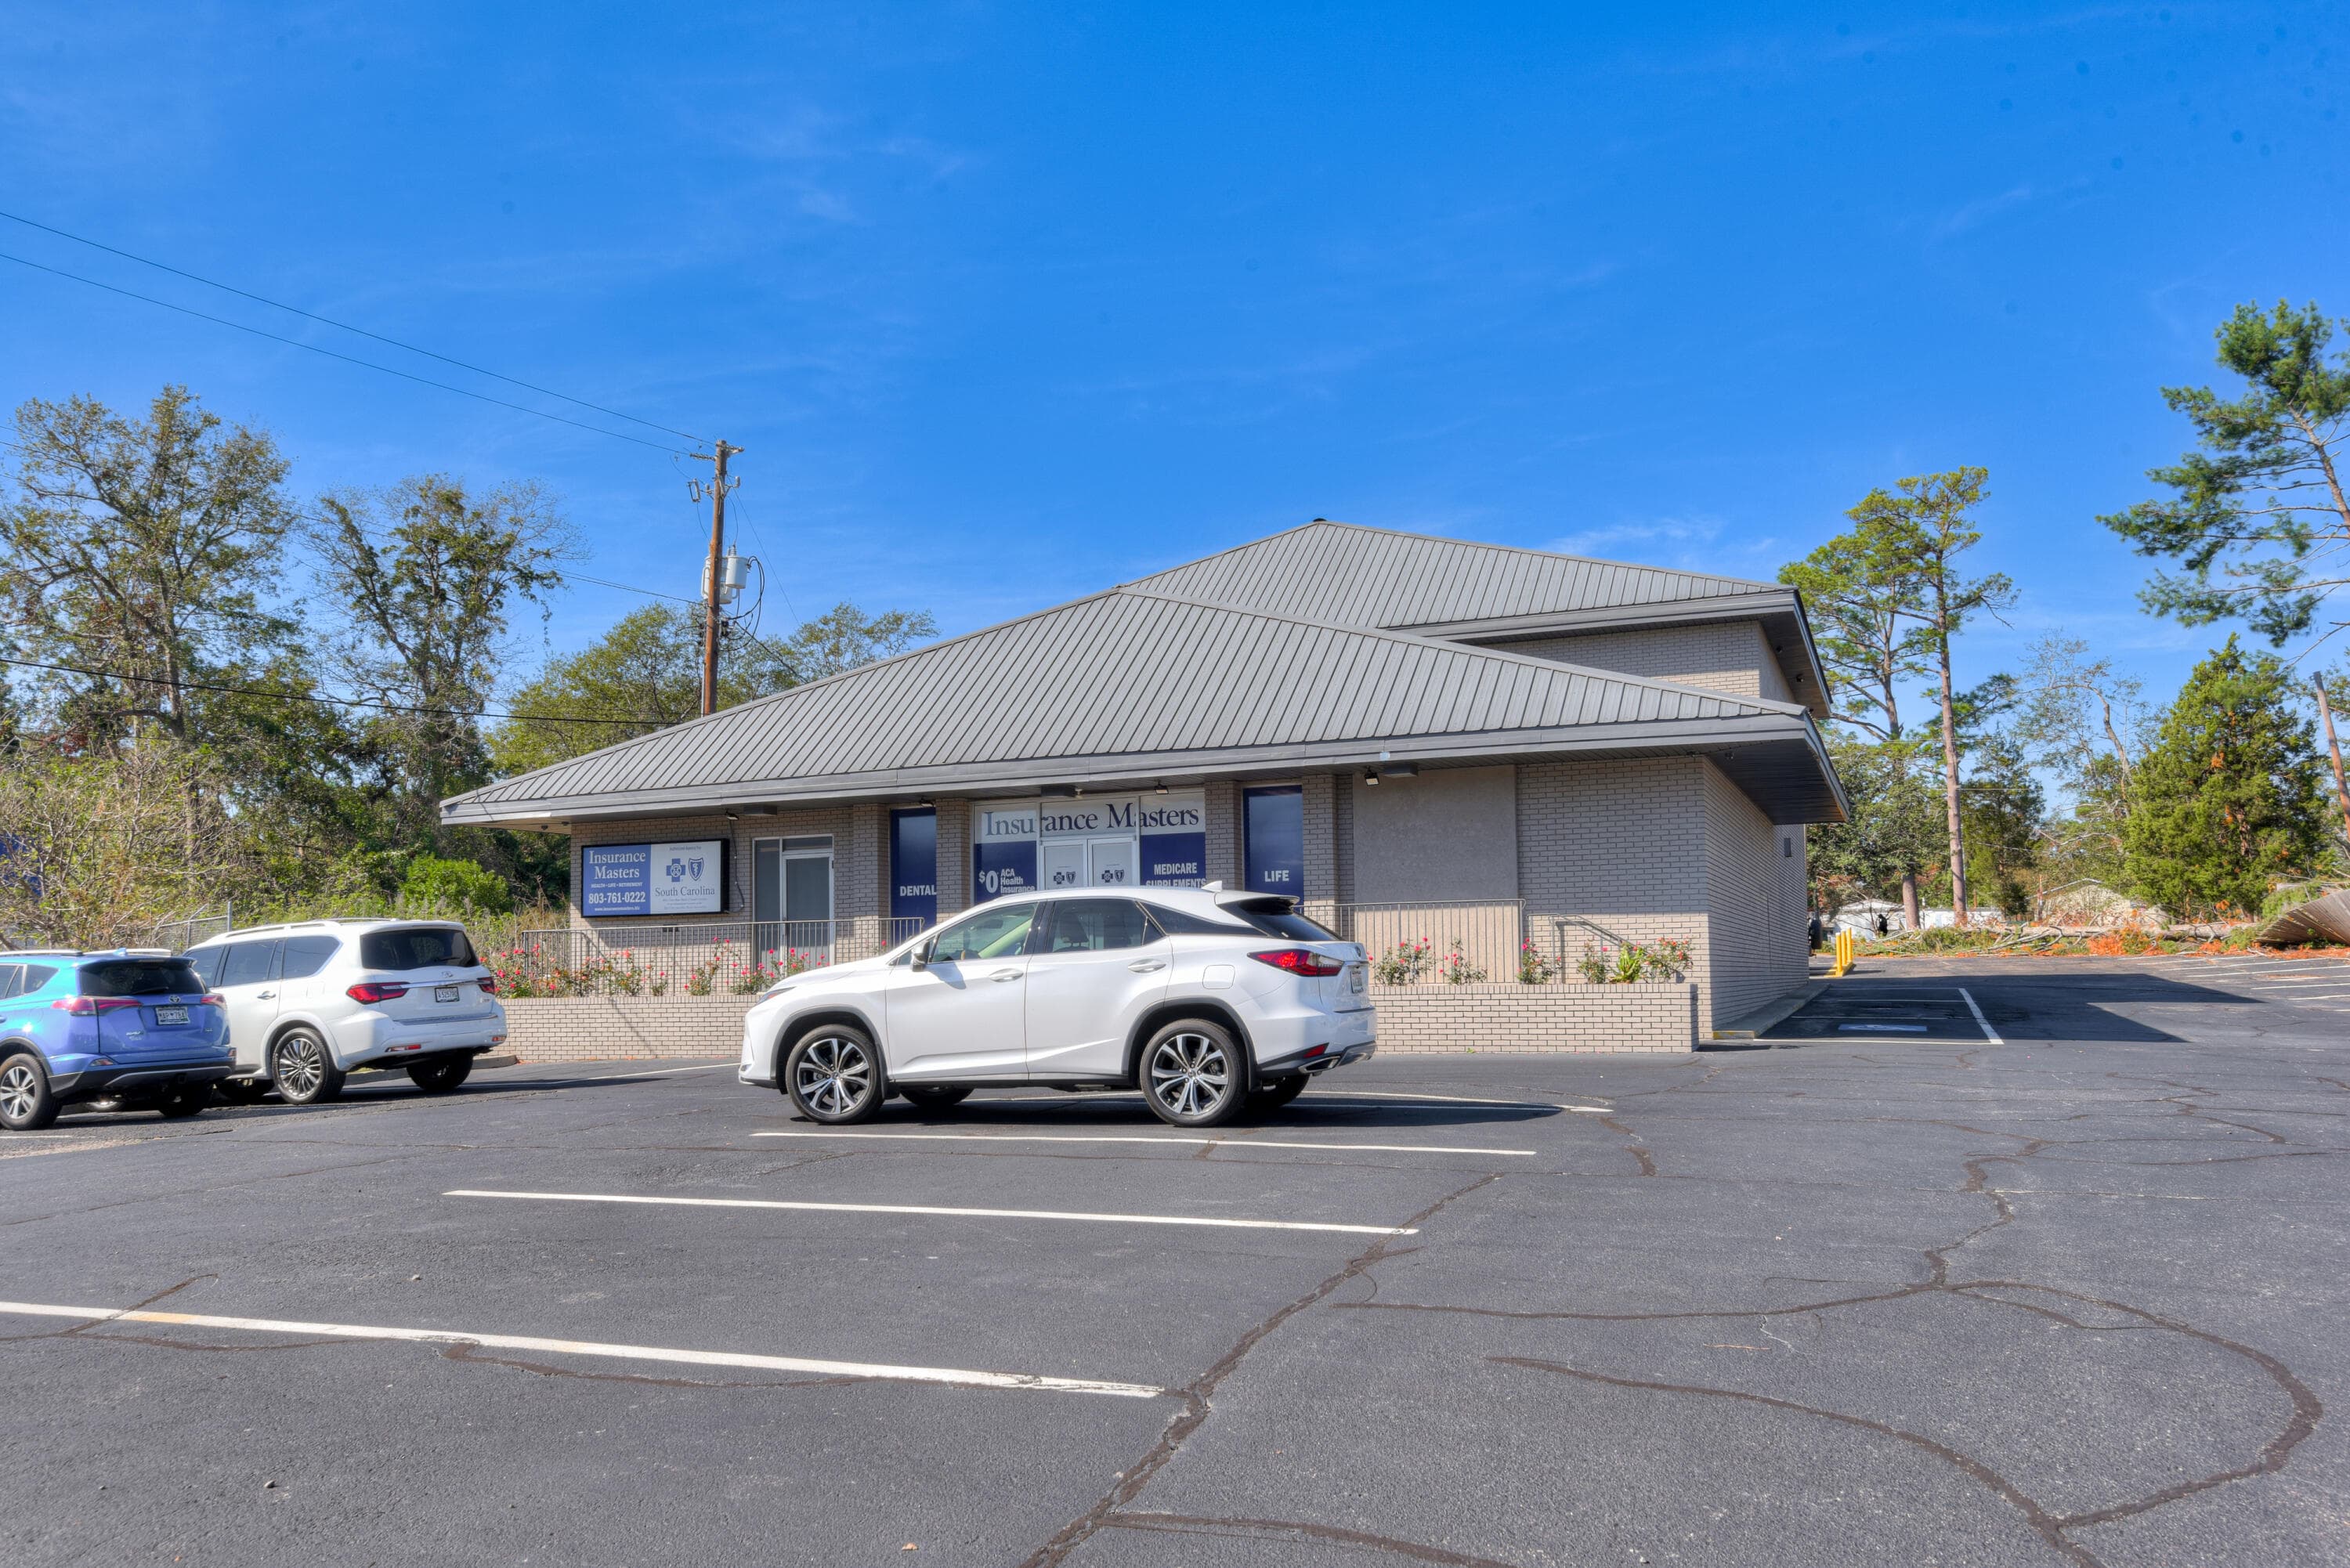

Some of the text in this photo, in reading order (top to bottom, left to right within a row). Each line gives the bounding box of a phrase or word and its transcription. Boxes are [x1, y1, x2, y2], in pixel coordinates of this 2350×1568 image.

[1105, 803, 1199, 829] Masters
[589, 851, 646, 864] Insurance
[594, 865, 640, 880] Masters
[1000, 869, 1015, 877] ACA
[1154, 862, 1198, 876] MEDICARE
[1000, 876, 1024, 886] Health
[1145, 877, 1206, 888] SUPPLEMENTS
[1264, 869, 1290, 883] LIFE
[655, 885, 715, 897] South Carolina
[900, 884, 937, 897] DENTAL
[1000, 885, 1036, 894] Insurance
[588, 891, 646, 904] 803-761-0222
